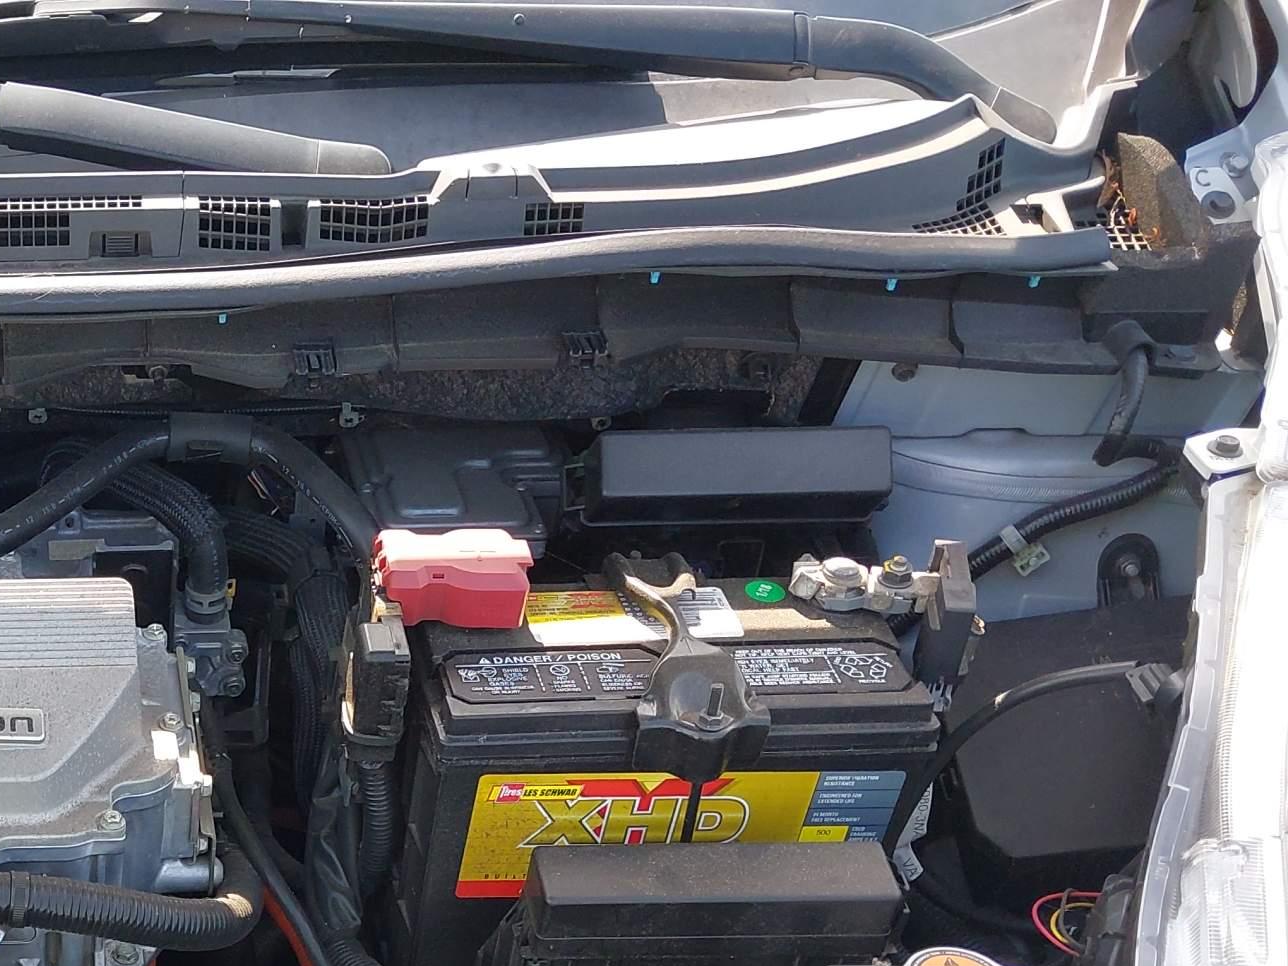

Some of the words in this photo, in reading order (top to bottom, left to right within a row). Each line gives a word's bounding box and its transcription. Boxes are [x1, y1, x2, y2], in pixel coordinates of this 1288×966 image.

[492, 655, 552, 664] DANGER
[566, 652, 622, 661] POISON
[523, 788, 537, 797] LES
[539, 788, 578, 797] SCHWAB
[517, 796, 750, 848] XHD
